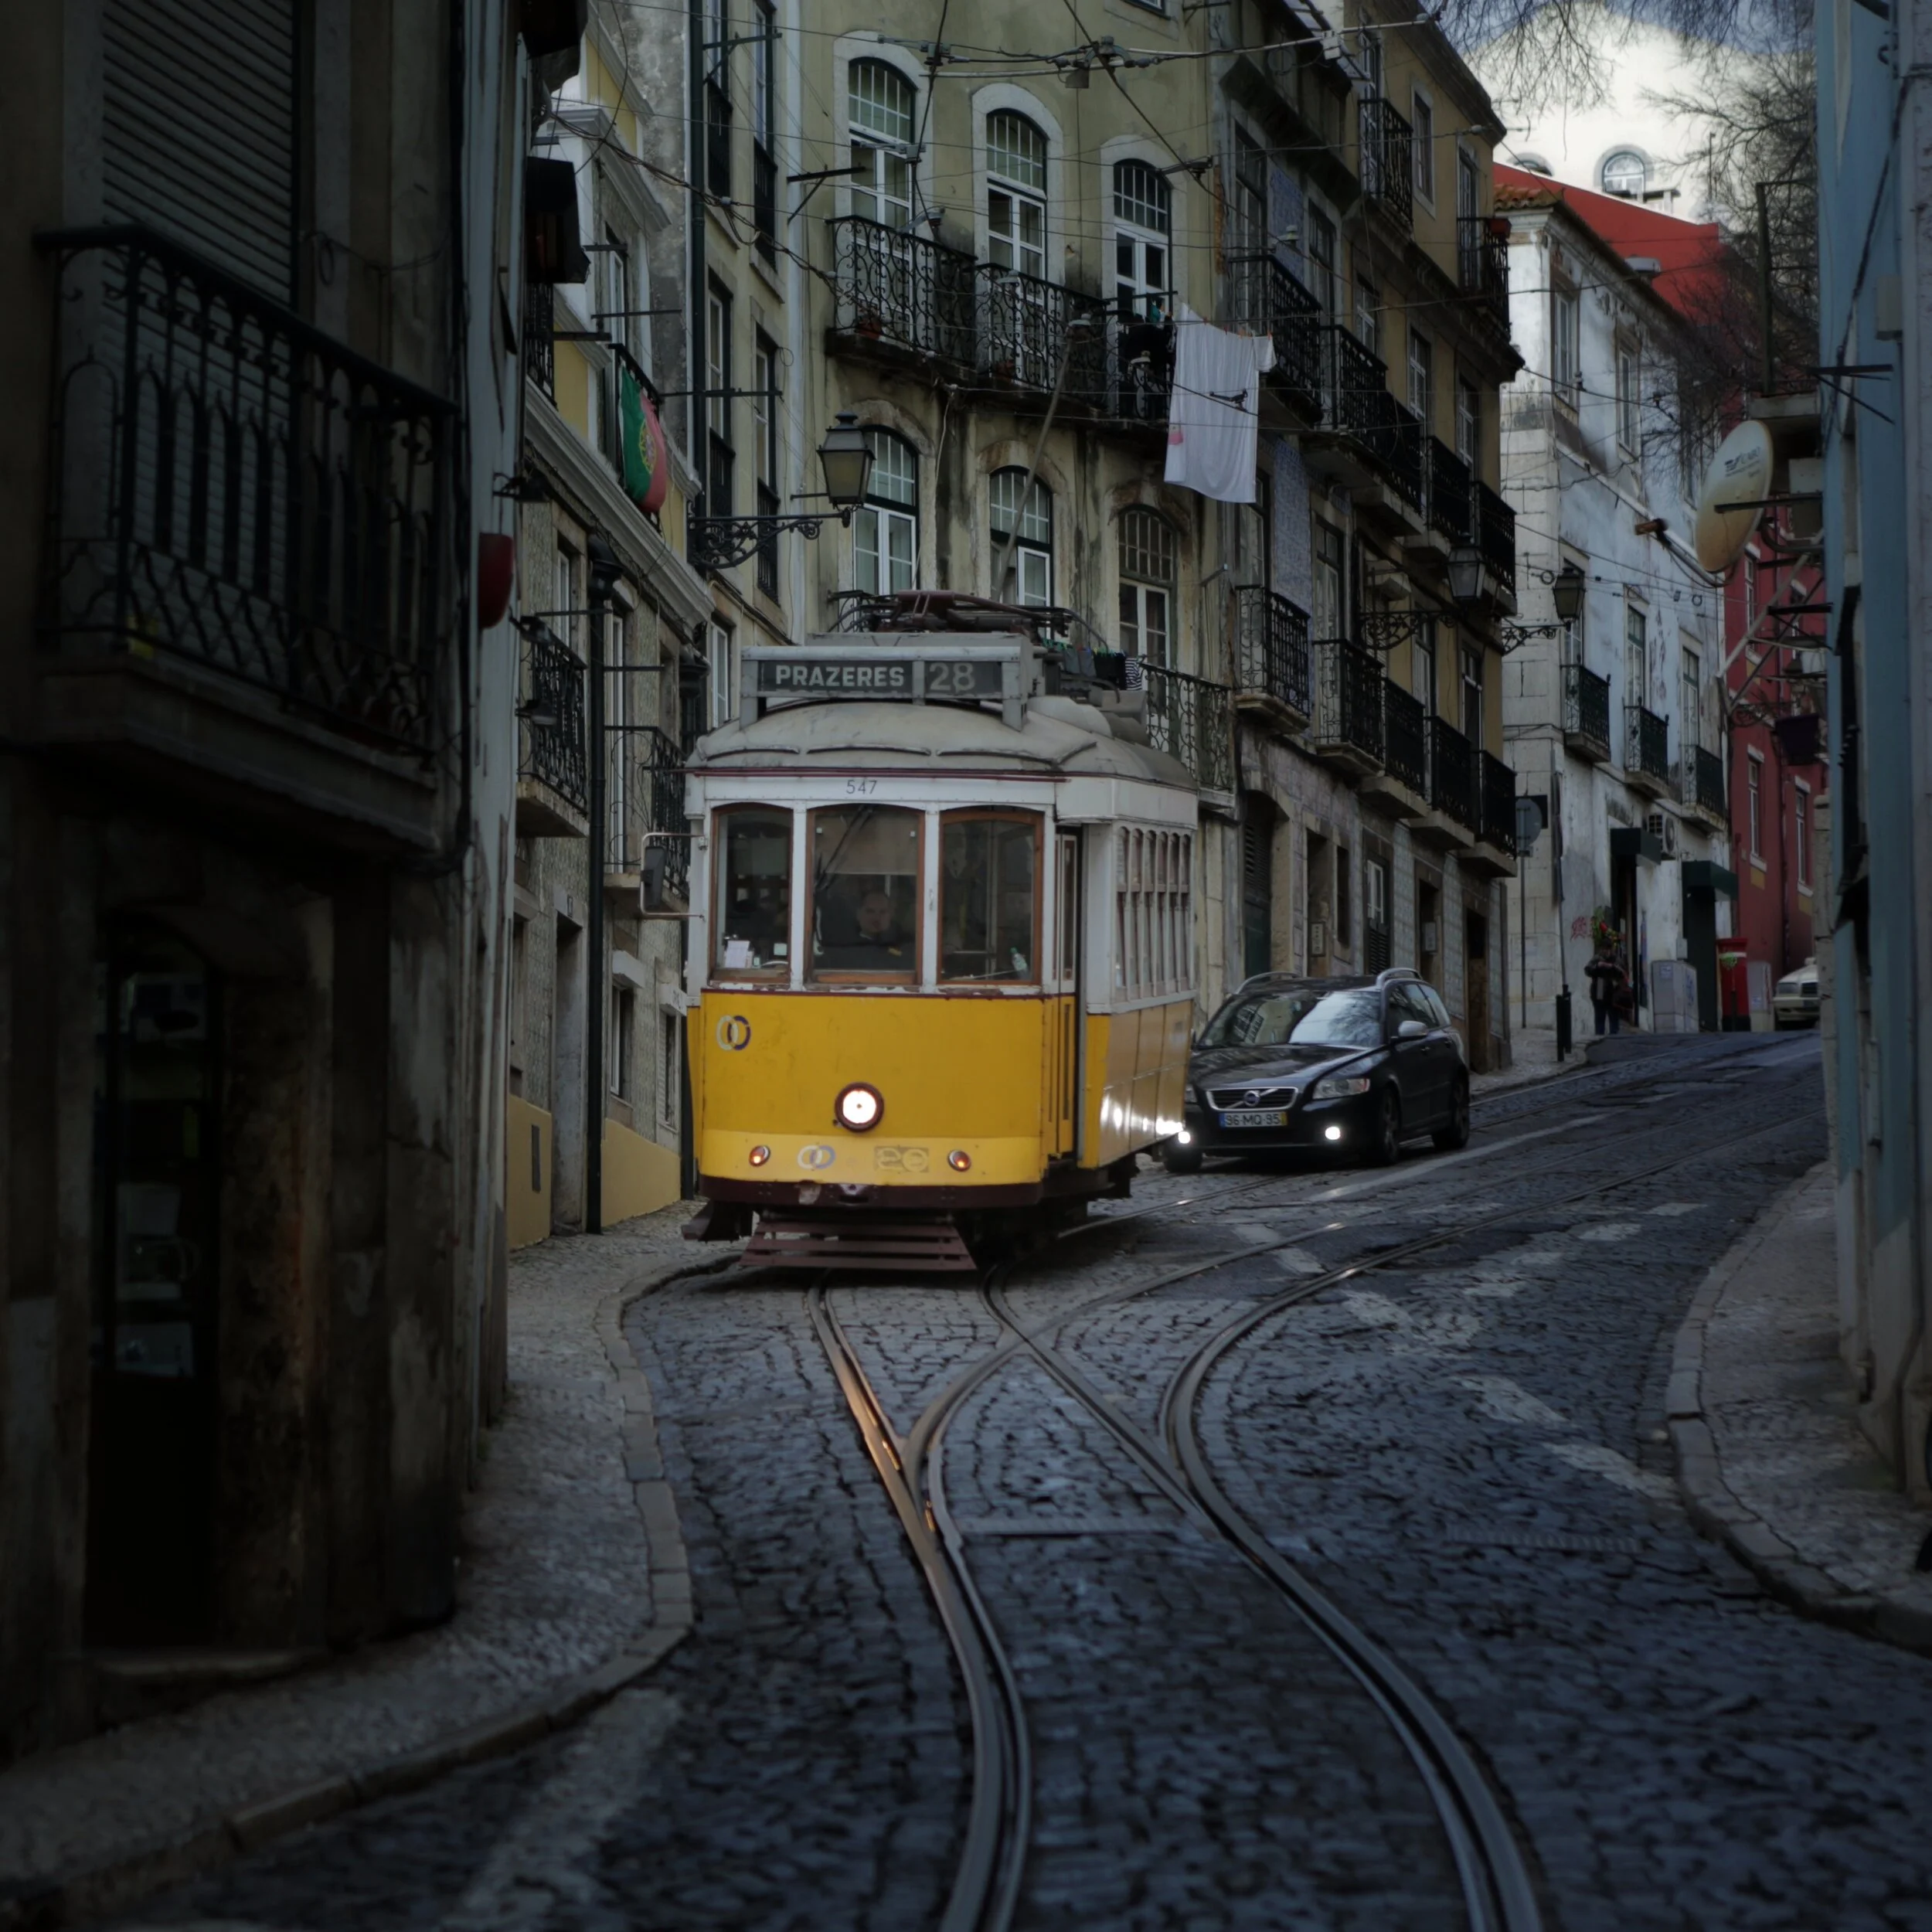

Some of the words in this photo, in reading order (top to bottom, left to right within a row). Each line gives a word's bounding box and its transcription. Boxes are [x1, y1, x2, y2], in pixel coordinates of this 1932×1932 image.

[775, 664, 905, 687] PRAZERES
[929, 662, 976, 693] 28
[845, 779, 877, 795] 547
